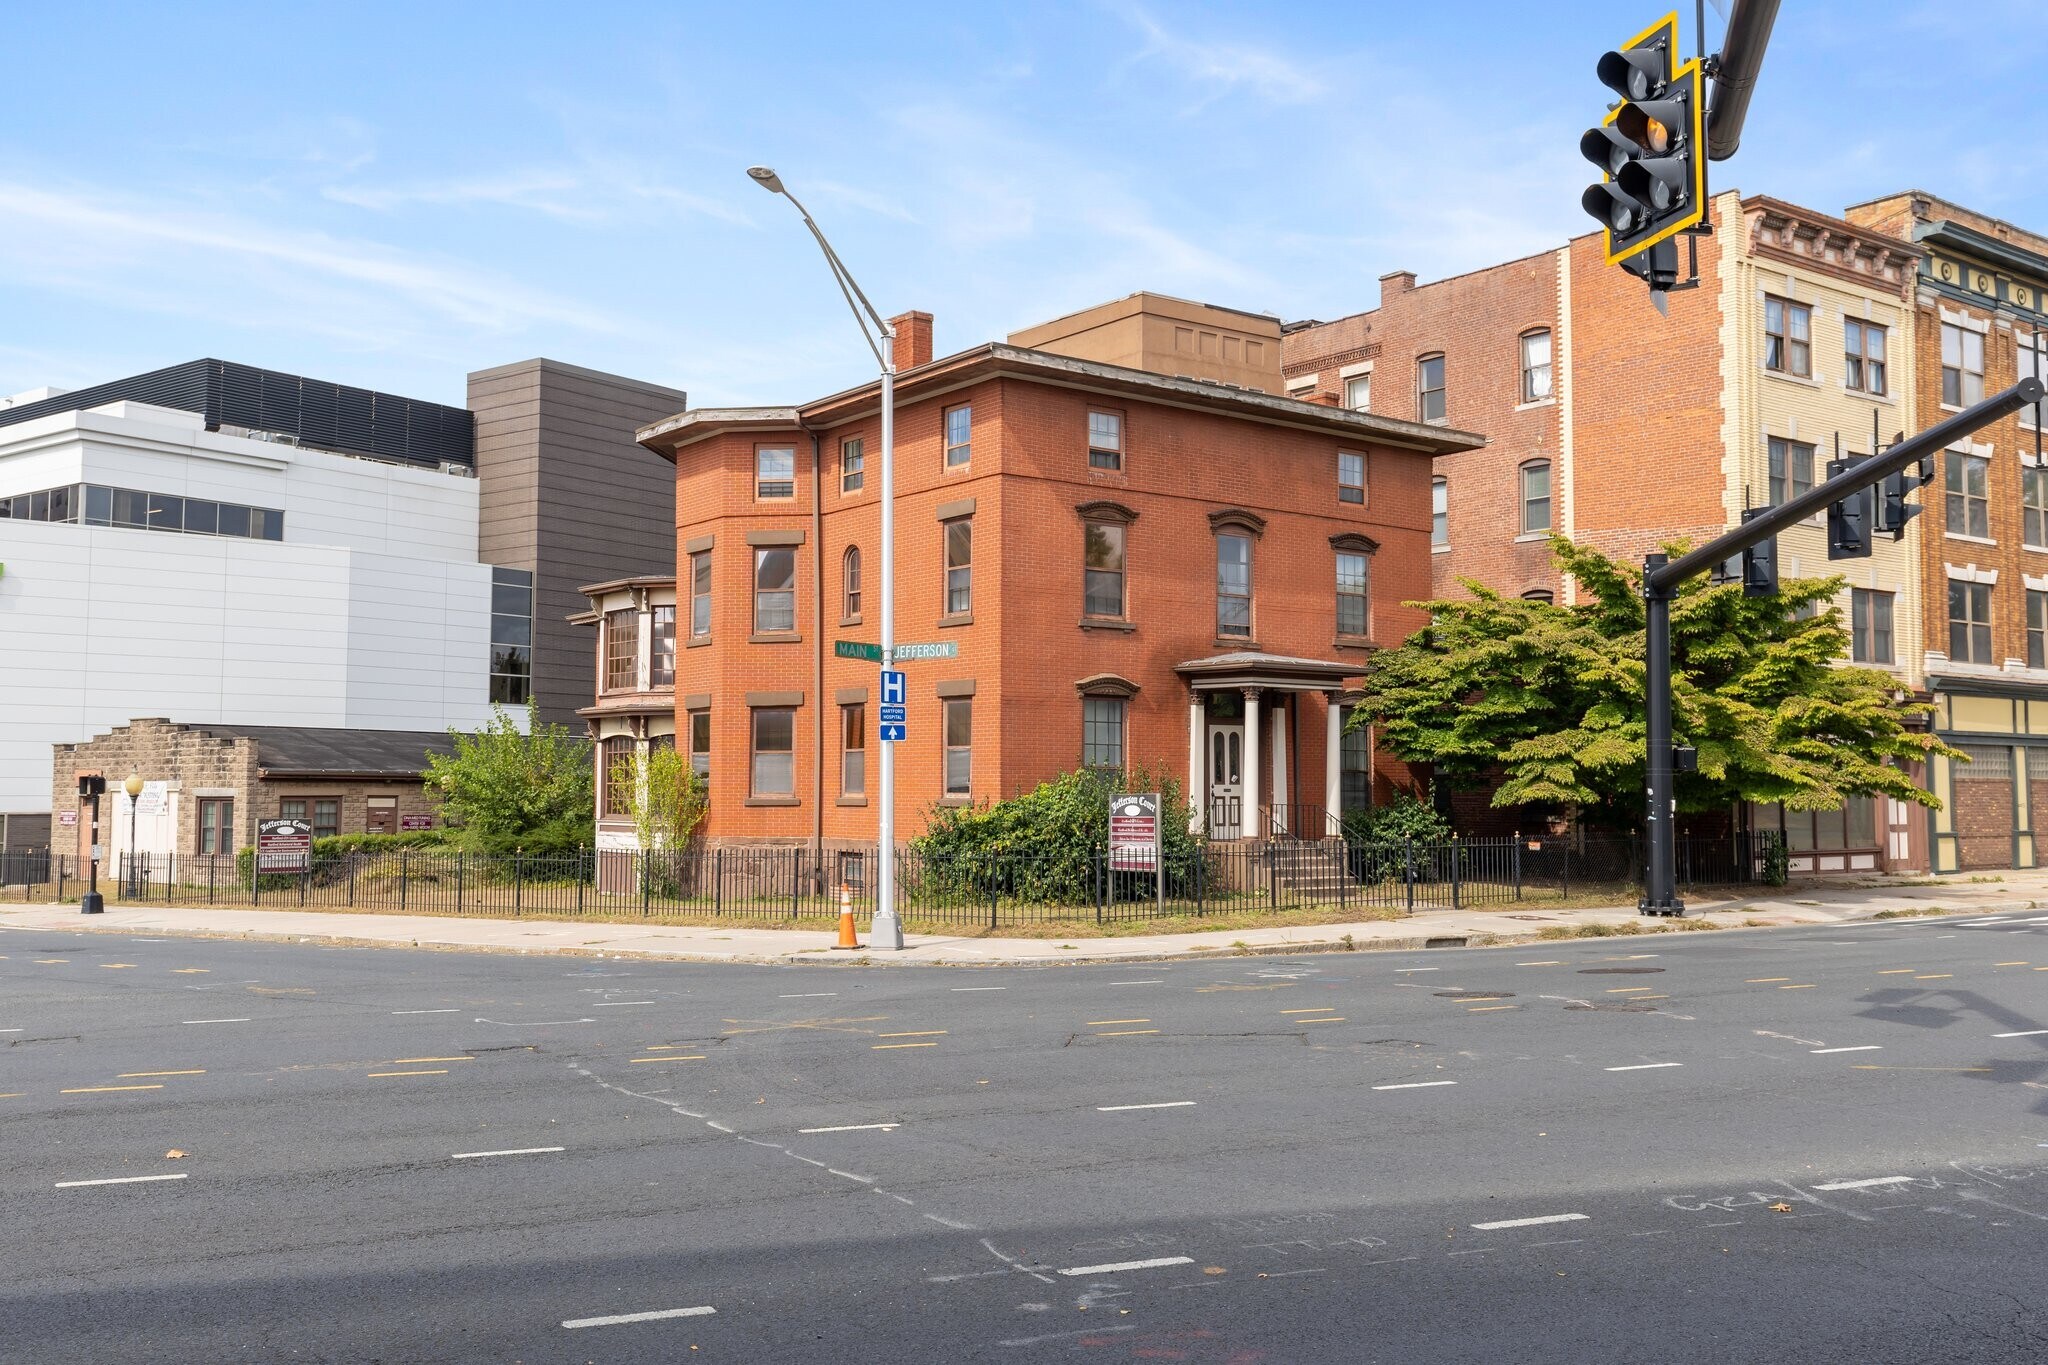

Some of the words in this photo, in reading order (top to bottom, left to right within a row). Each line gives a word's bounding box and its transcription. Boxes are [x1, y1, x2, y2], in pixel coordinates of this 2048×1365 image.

[839, 643, 867, 658] MAIN
[894, 643, 949, 658] JEFFERSON
[884, 673, 902, 702] H
[1111, 796, 1138, 814] Jefferson
[1138, 796, 1156, 813] Court
[259, 819, 291, 833] Jefferson
[292, 819, 311, 832] Court
